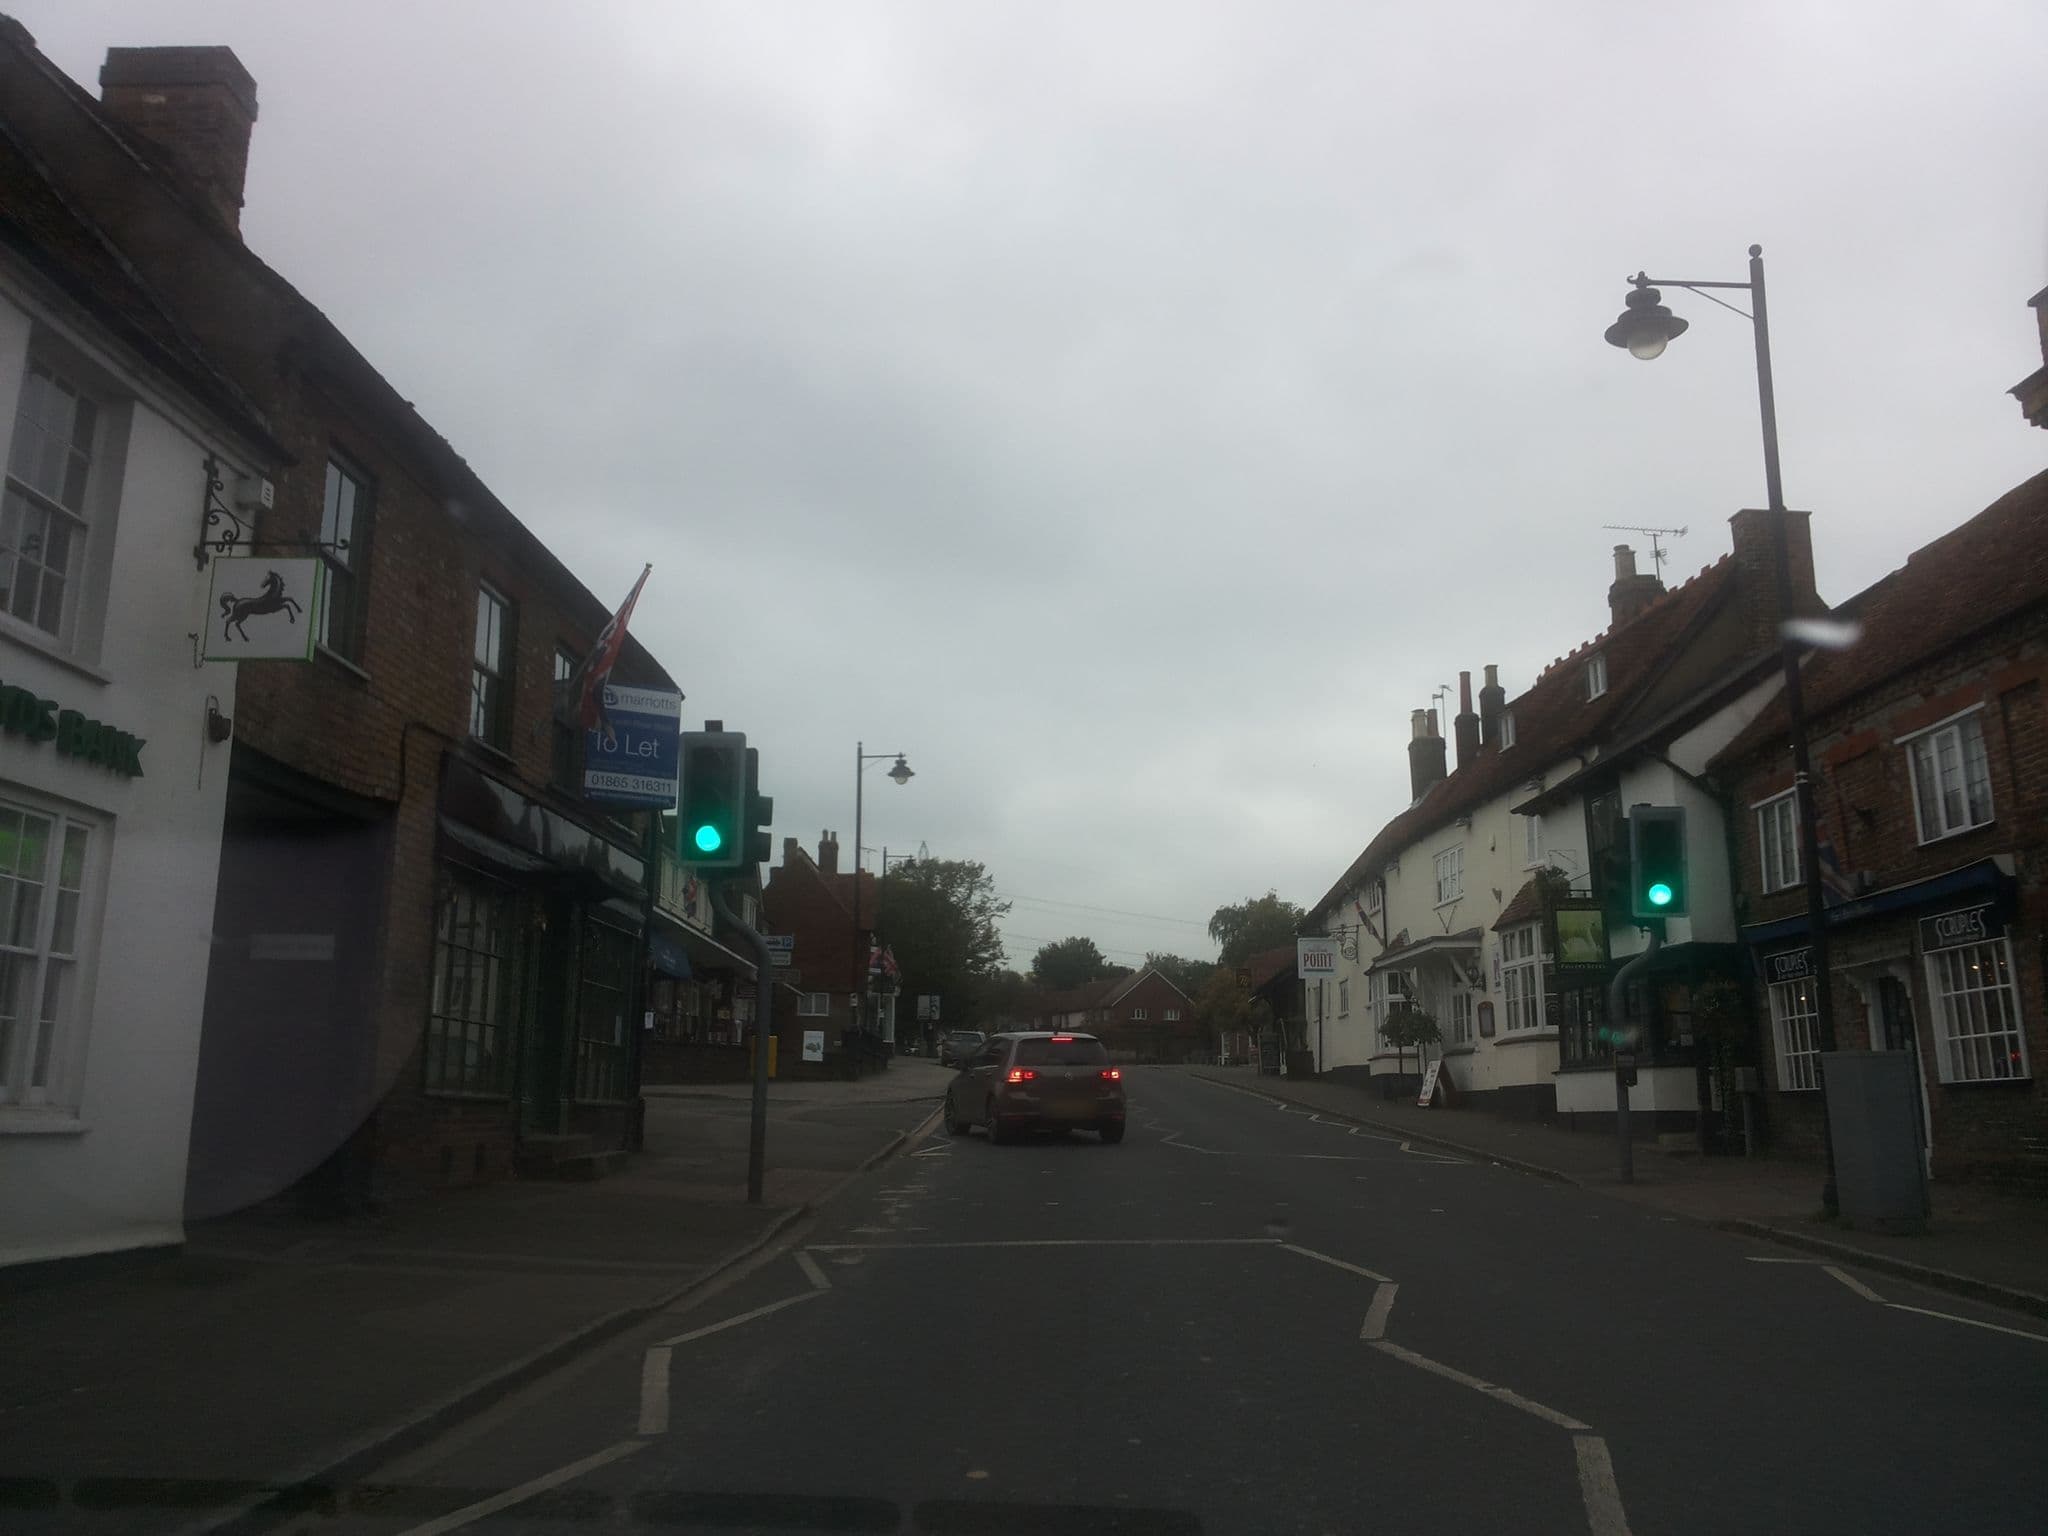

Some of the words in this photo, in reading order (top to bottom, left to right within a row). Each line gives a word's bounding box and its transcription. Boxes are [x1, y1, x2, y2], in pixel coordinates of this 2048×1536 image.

[587, 728, 618, 753] To
[625, 734, 659, 758] Let
[591, 774, 629, 789] 01865
[632, 779, 672, 793] 316311
[1303, 952, 1334, 968] POINT
